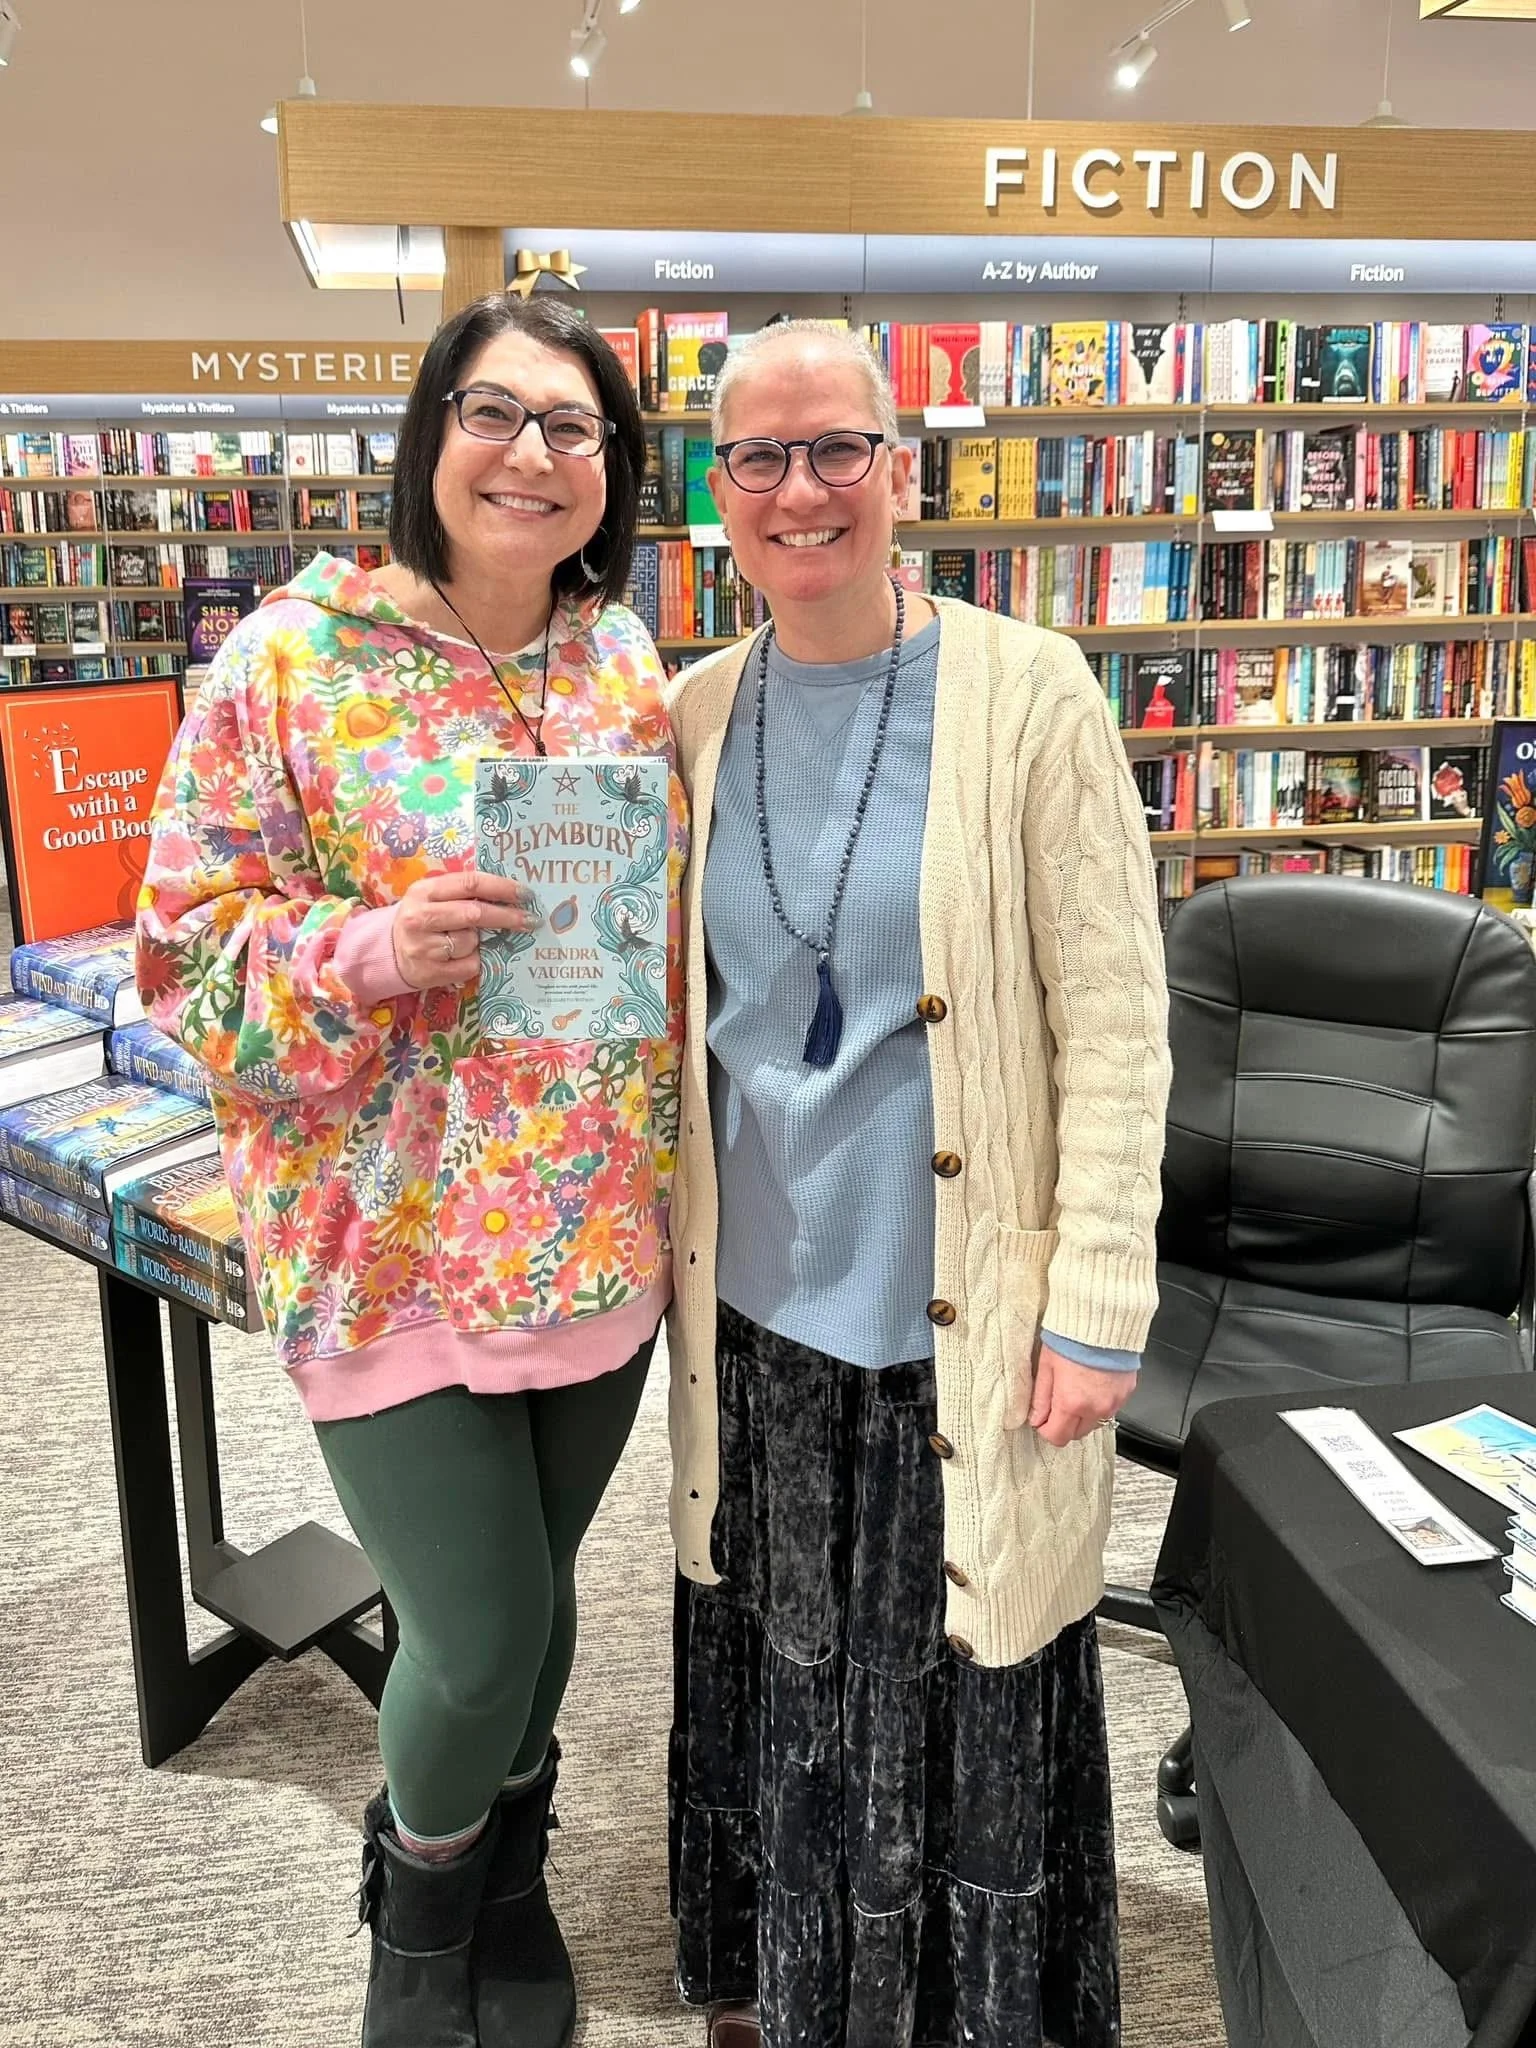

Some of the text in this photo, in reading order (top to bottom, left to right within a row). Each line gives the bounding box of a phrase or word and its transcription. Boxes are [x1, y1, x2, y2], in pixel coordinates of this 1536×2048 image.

[984, 148, 1338, 211] FICTION
[654, 259, 714, 280] Fiction
[982, 262, 1099, 284] A-Z by Author
[1350, 263, 1405, 282] Fiction
[666, 322, 725, 339] CARMEN
[1325, 327, 1369, 343] JAWS
[191, 352, 424, 382] MYSTERIE
[668, 374, 716, 393] GRACE
[10, 403, 49, 414] Thrillers
[141, 402, 235, 415] Mysteries & Thrillers
[327, 402, 407, 416] Mysteries & Thrill
[201, 606, 240, 617] SHE'S
[201, 618, 240, 632] NOT
[200, 633, 227, 644] SOR
[1138, 663, 1184, 675] ATWOOD
[49, 746, 148, 794] Escape
[1378, 770, 1416, 787] FICTION
[68, 792, 137, 819] with a
[1378, 787, 1416, 806] WRITER
[552, 803, 580, 816] THE
[42, 818, 154, 852] Good Boo
[493, 820, 639, 861] PLYMBURY
[514, 856, 613, 885] WITCH
[534, 947, 600, 961] KENDRA
[528, 966, 605, 979] VAUGHAN
[31, 970, 53, 994] WIND
[54, 981, 66, 996] AND
[66, 981, 93, 1009] TRUTH
[133, 1054, 205, 1099] WIND AND TRUTH
[25, 1083, 140, 1128] SANDERSON
[26, 1083, 108, 1115] BRANDON
[10, 1143, 82, 1194] WIND AND TRUTH
[18, 1193, 91, 1247] WIND AND TRUTH
[138, 1215, 220, 1270] WORDS OF RADIANCE
[140, 1255, 222, 1310] WORDS OF RADIANCE
